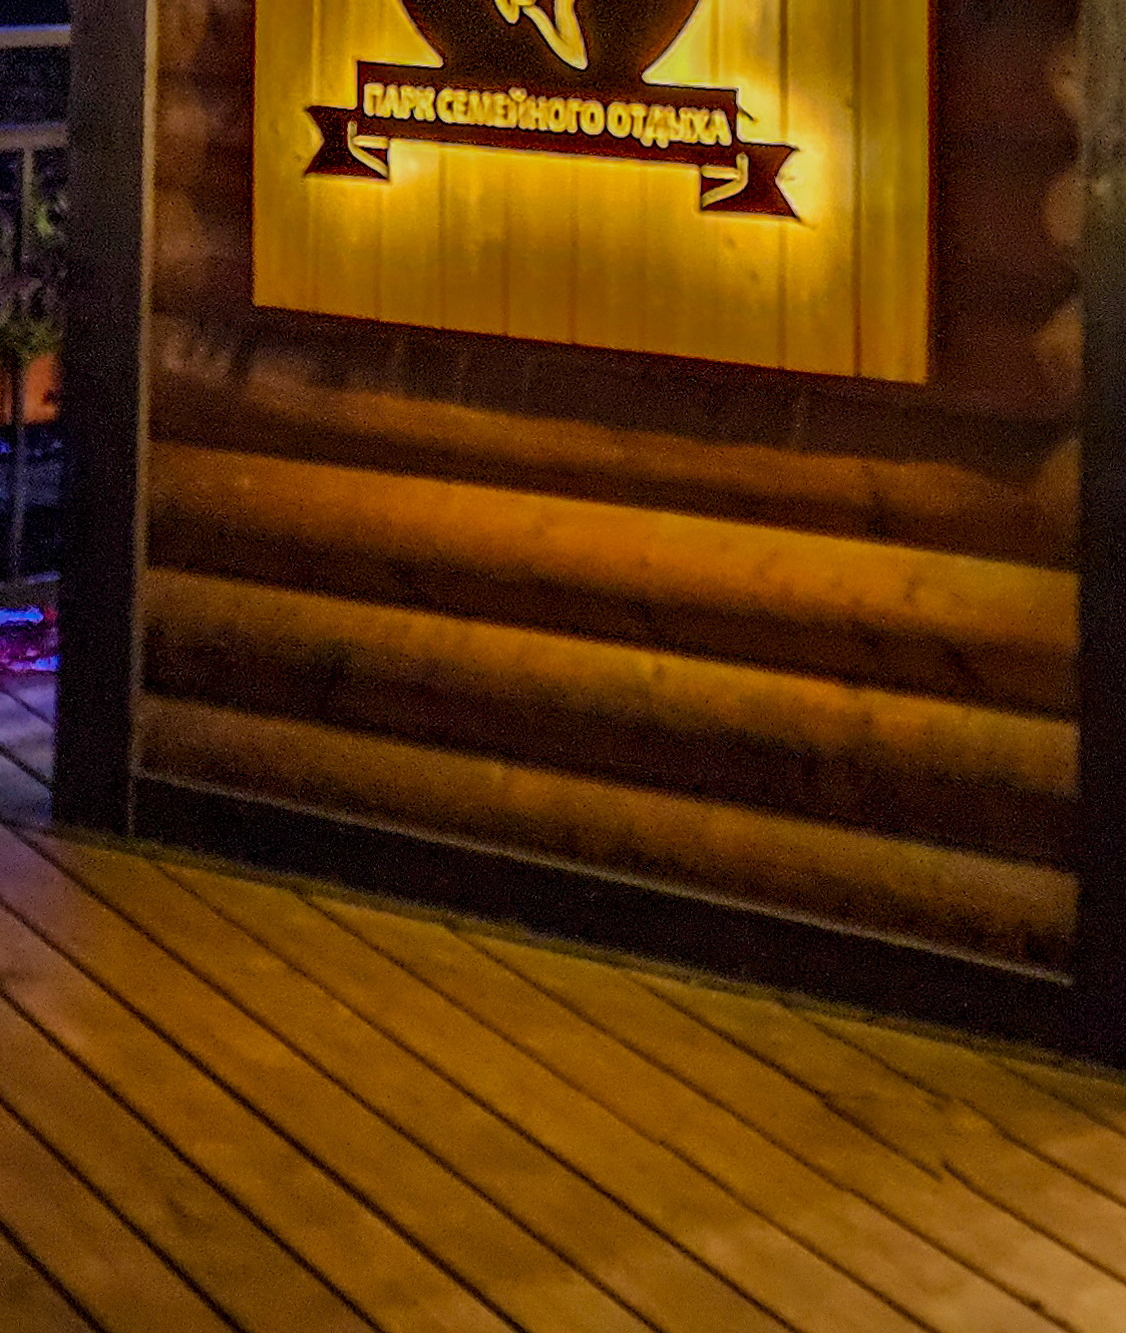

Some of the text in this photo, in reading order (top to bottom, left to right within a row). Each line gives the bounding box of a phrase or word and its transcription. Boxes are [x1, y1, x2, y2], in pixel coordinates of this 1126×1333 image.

[363, 83, 732, 148] ПАРК СЕМЕЙНОГО ОТДЫХА
